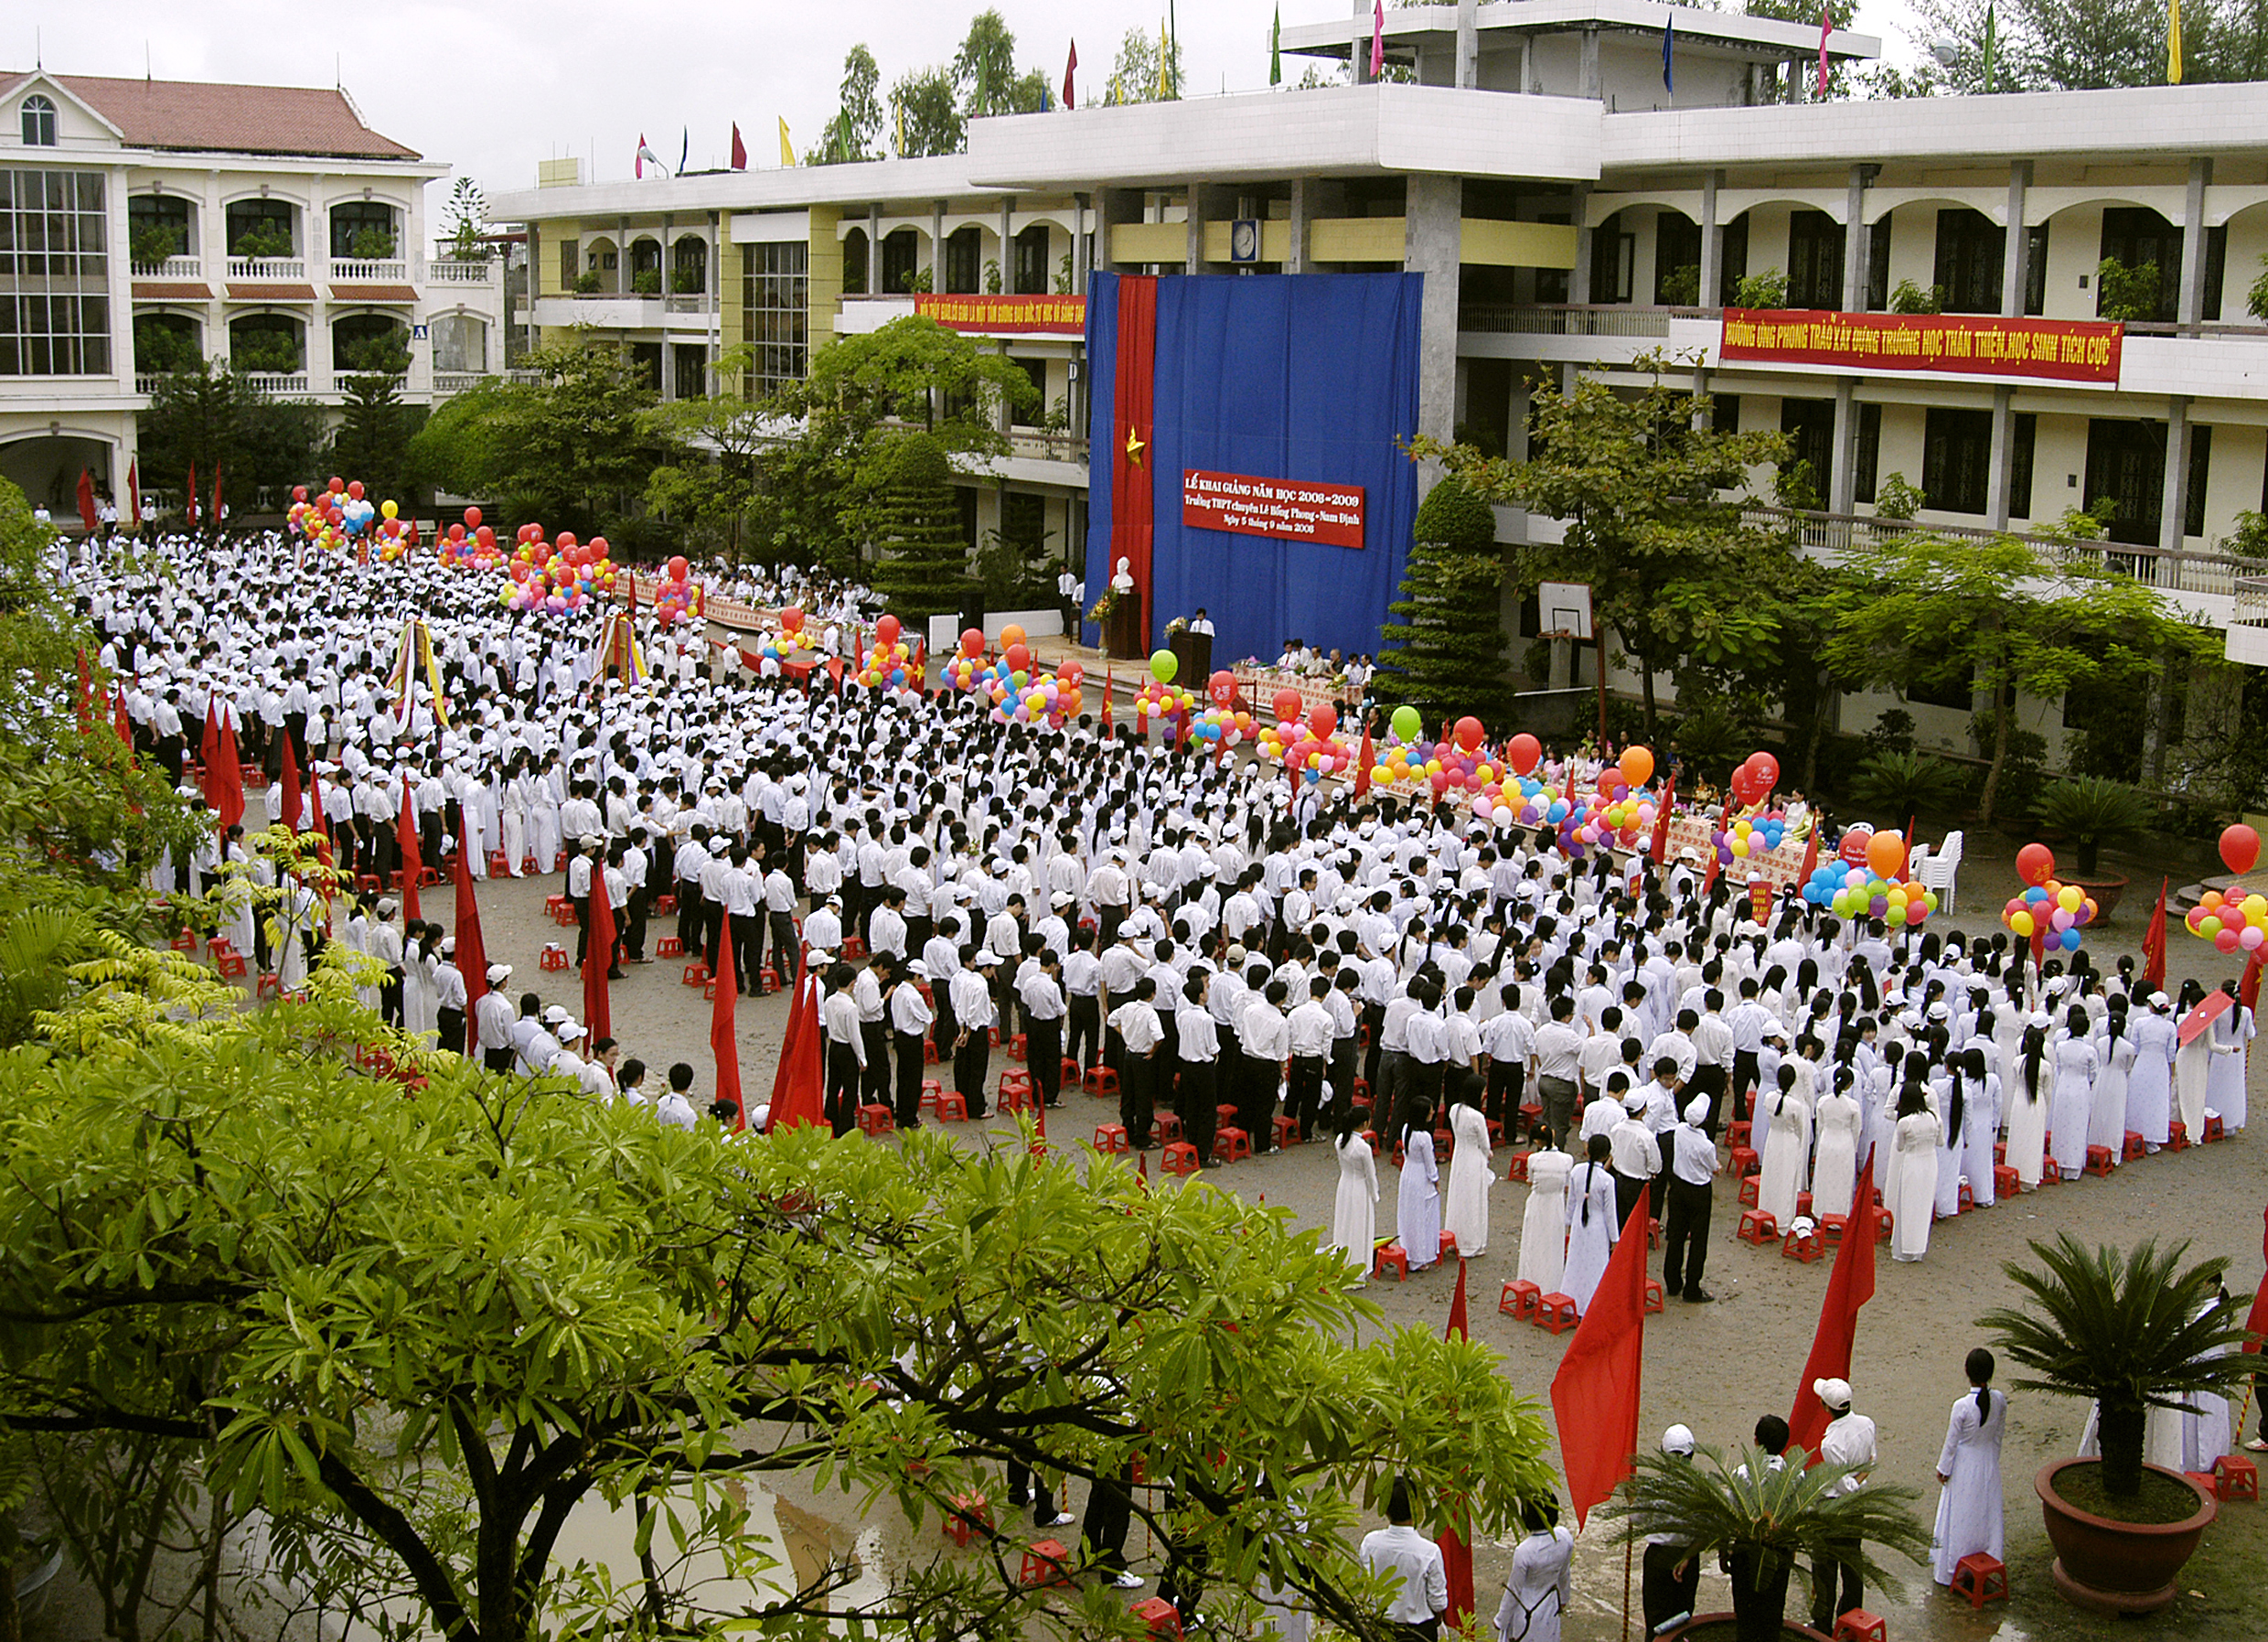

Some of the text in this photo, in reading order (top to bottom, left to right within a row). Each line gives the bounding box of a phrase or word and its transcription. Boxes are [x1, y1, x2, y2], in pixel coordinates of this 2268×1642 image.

[1777, 323, 1809, 349] PHONG
[1882, 322, 1920, 356] TRƯỜNG
[1922, 329, 1943, 362] HỌC
[1945, 324, 1972, 358] THÂN
[2031, 331, 2059, 362] SINH
[2061, 328, 2086, 364] TÍCH
[1069, 363, 1078, 380] D
[1200, 479, 1222, 493] KHAI
[1223, 478, 1251, 496] GIẢNG
[1252, 483, 1274, 499] NĂM
[1276, 488, 1297, 503] HỌC
[1212, 498, 1232, 510] THPT
[1232, 500, 1258, 515] chuyên
[1259, 504, 1269, 515] Lê
[1339, 512, 1360, 526] Định
[1224, 514, 1240, 527] Ngày
[1248, 517, 1268, 531] tháng
[1276, 521, 1293, 531] năm
